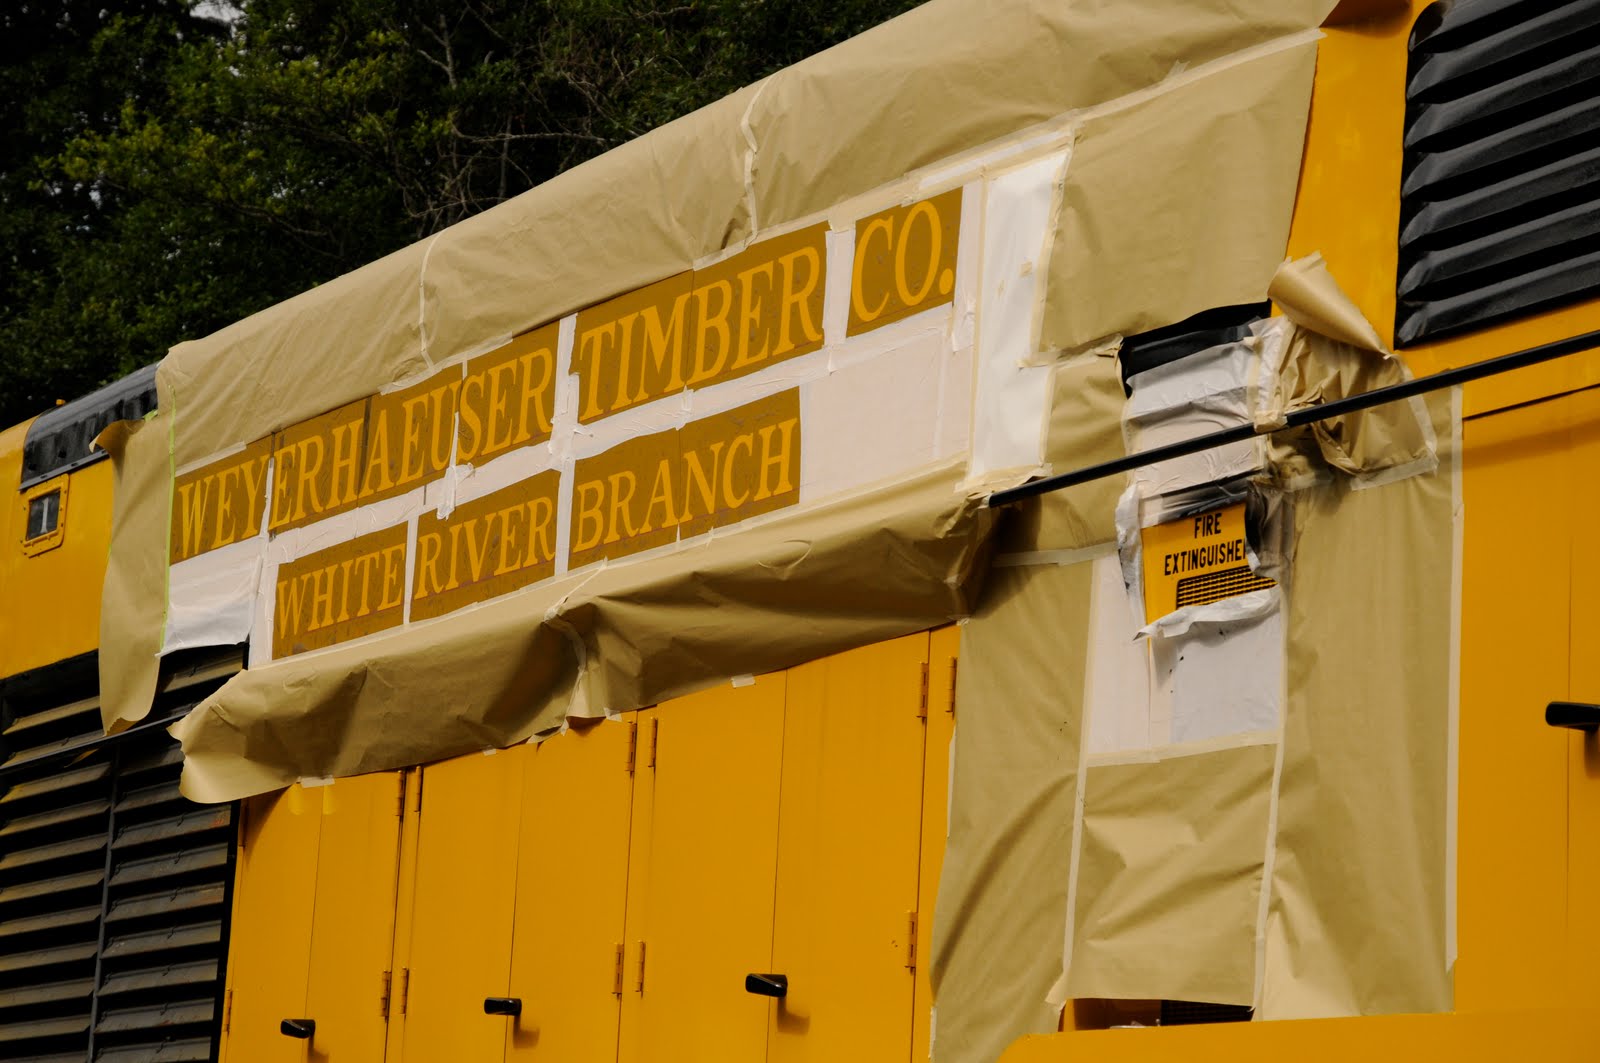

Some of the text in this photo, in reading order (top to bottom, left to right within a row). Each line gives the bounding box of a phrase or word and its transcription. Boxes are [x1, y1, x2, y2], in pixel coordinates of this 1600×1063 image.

[178, 200, 954, 560] WEYERHAEUSER TIMBER CO.
[276, 417, 798, 640] WHITE RIVER BRANCH
[1194, 512, 1222, 538] FIRE
